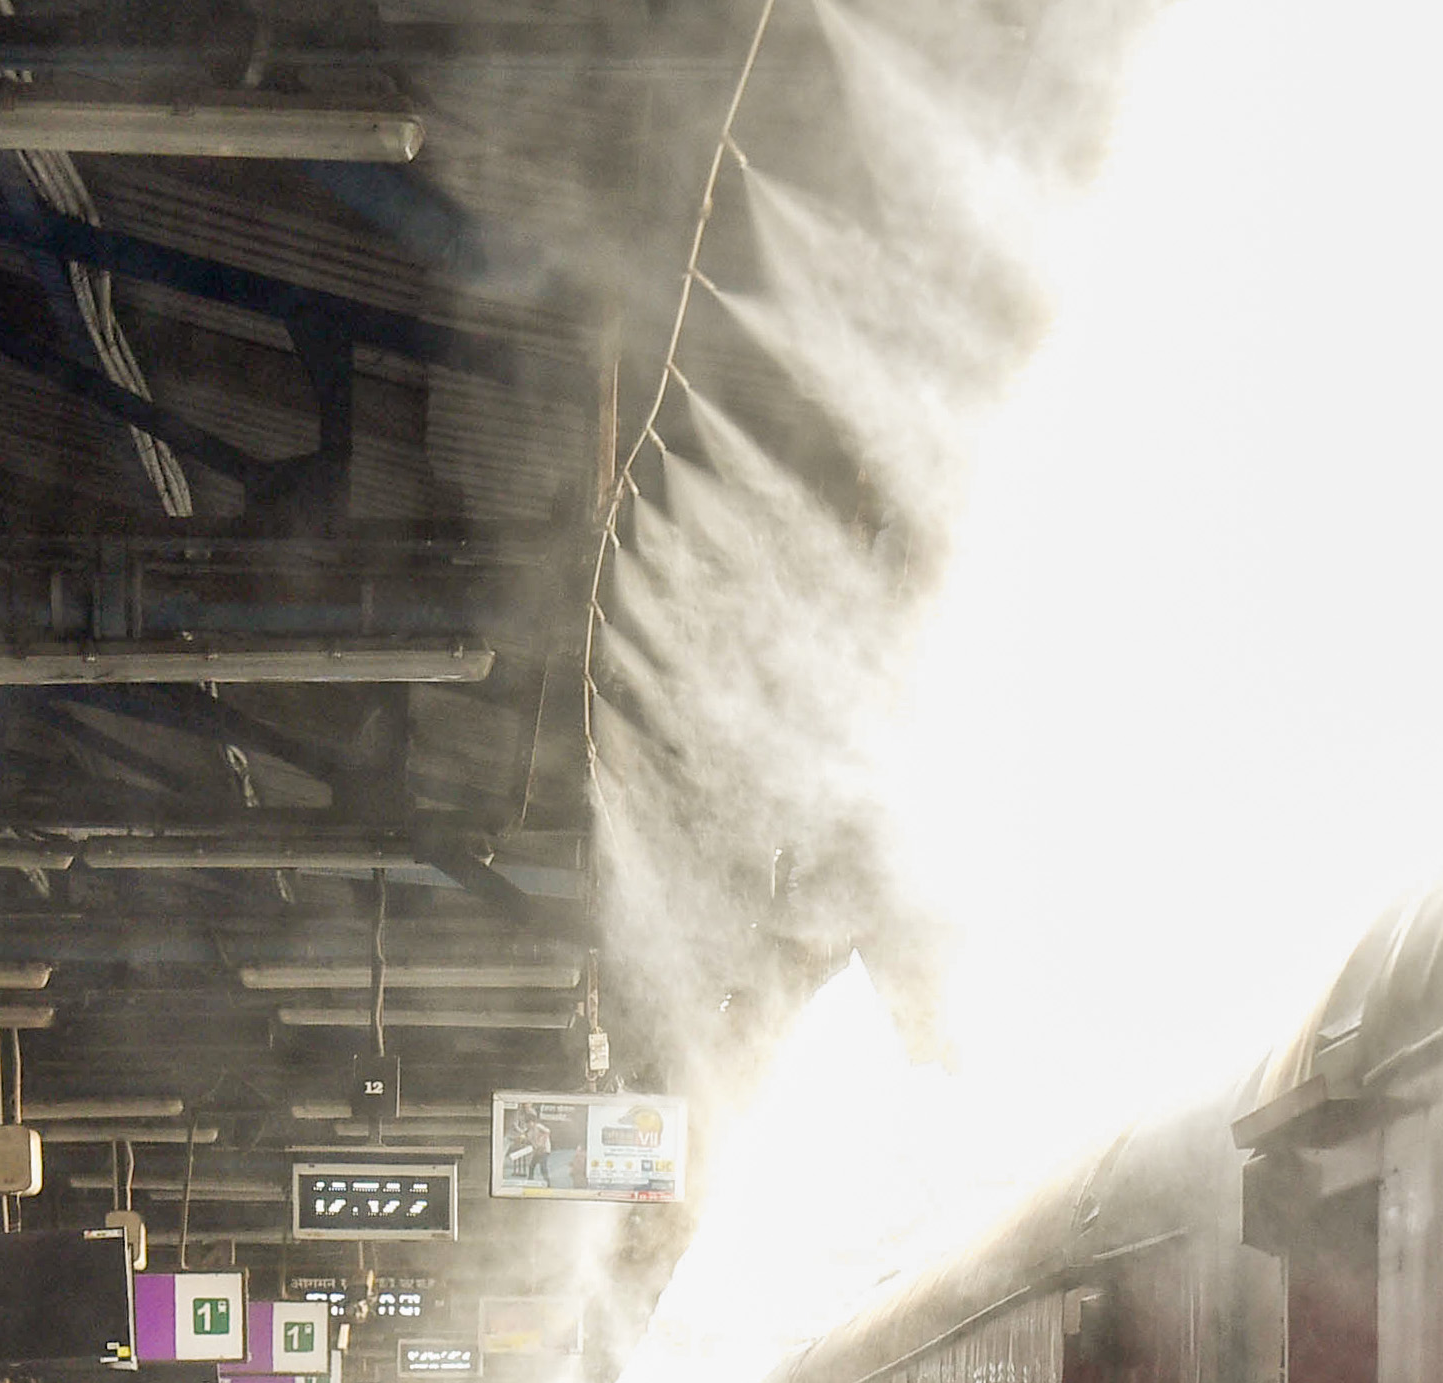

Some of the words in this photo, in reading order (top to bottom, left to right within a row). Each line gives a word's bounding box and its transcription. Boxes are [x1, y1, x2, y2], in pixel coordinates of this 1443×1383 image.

[364, 1081, 384, 1095] 12
[196, 1302, 212, 1332] 1
[286, 1325, 300, 1350] 1
